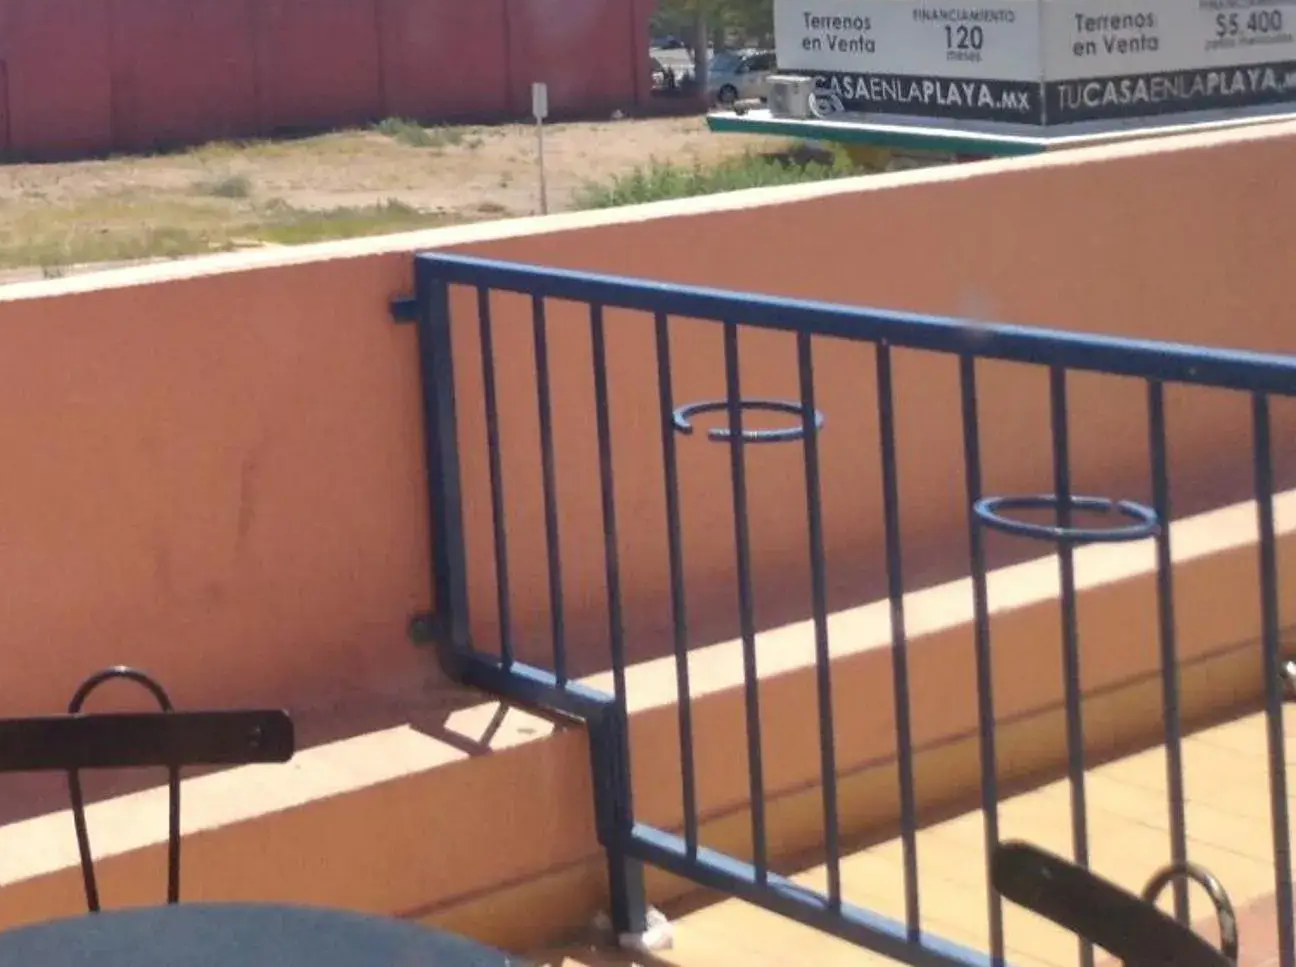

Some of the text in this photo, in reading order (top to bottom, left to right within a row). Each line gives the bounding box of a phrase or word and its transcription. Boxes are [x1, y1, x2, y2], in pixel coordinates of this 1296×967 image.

[803, 11, 872, 31] Terrenos
[1074, 11, 1155, 33] Terrenos
[802, 33, 876, 53] en Venta
[945, 25, 984, 50] 120
[1072, 33, 1160, 56] en Venta
